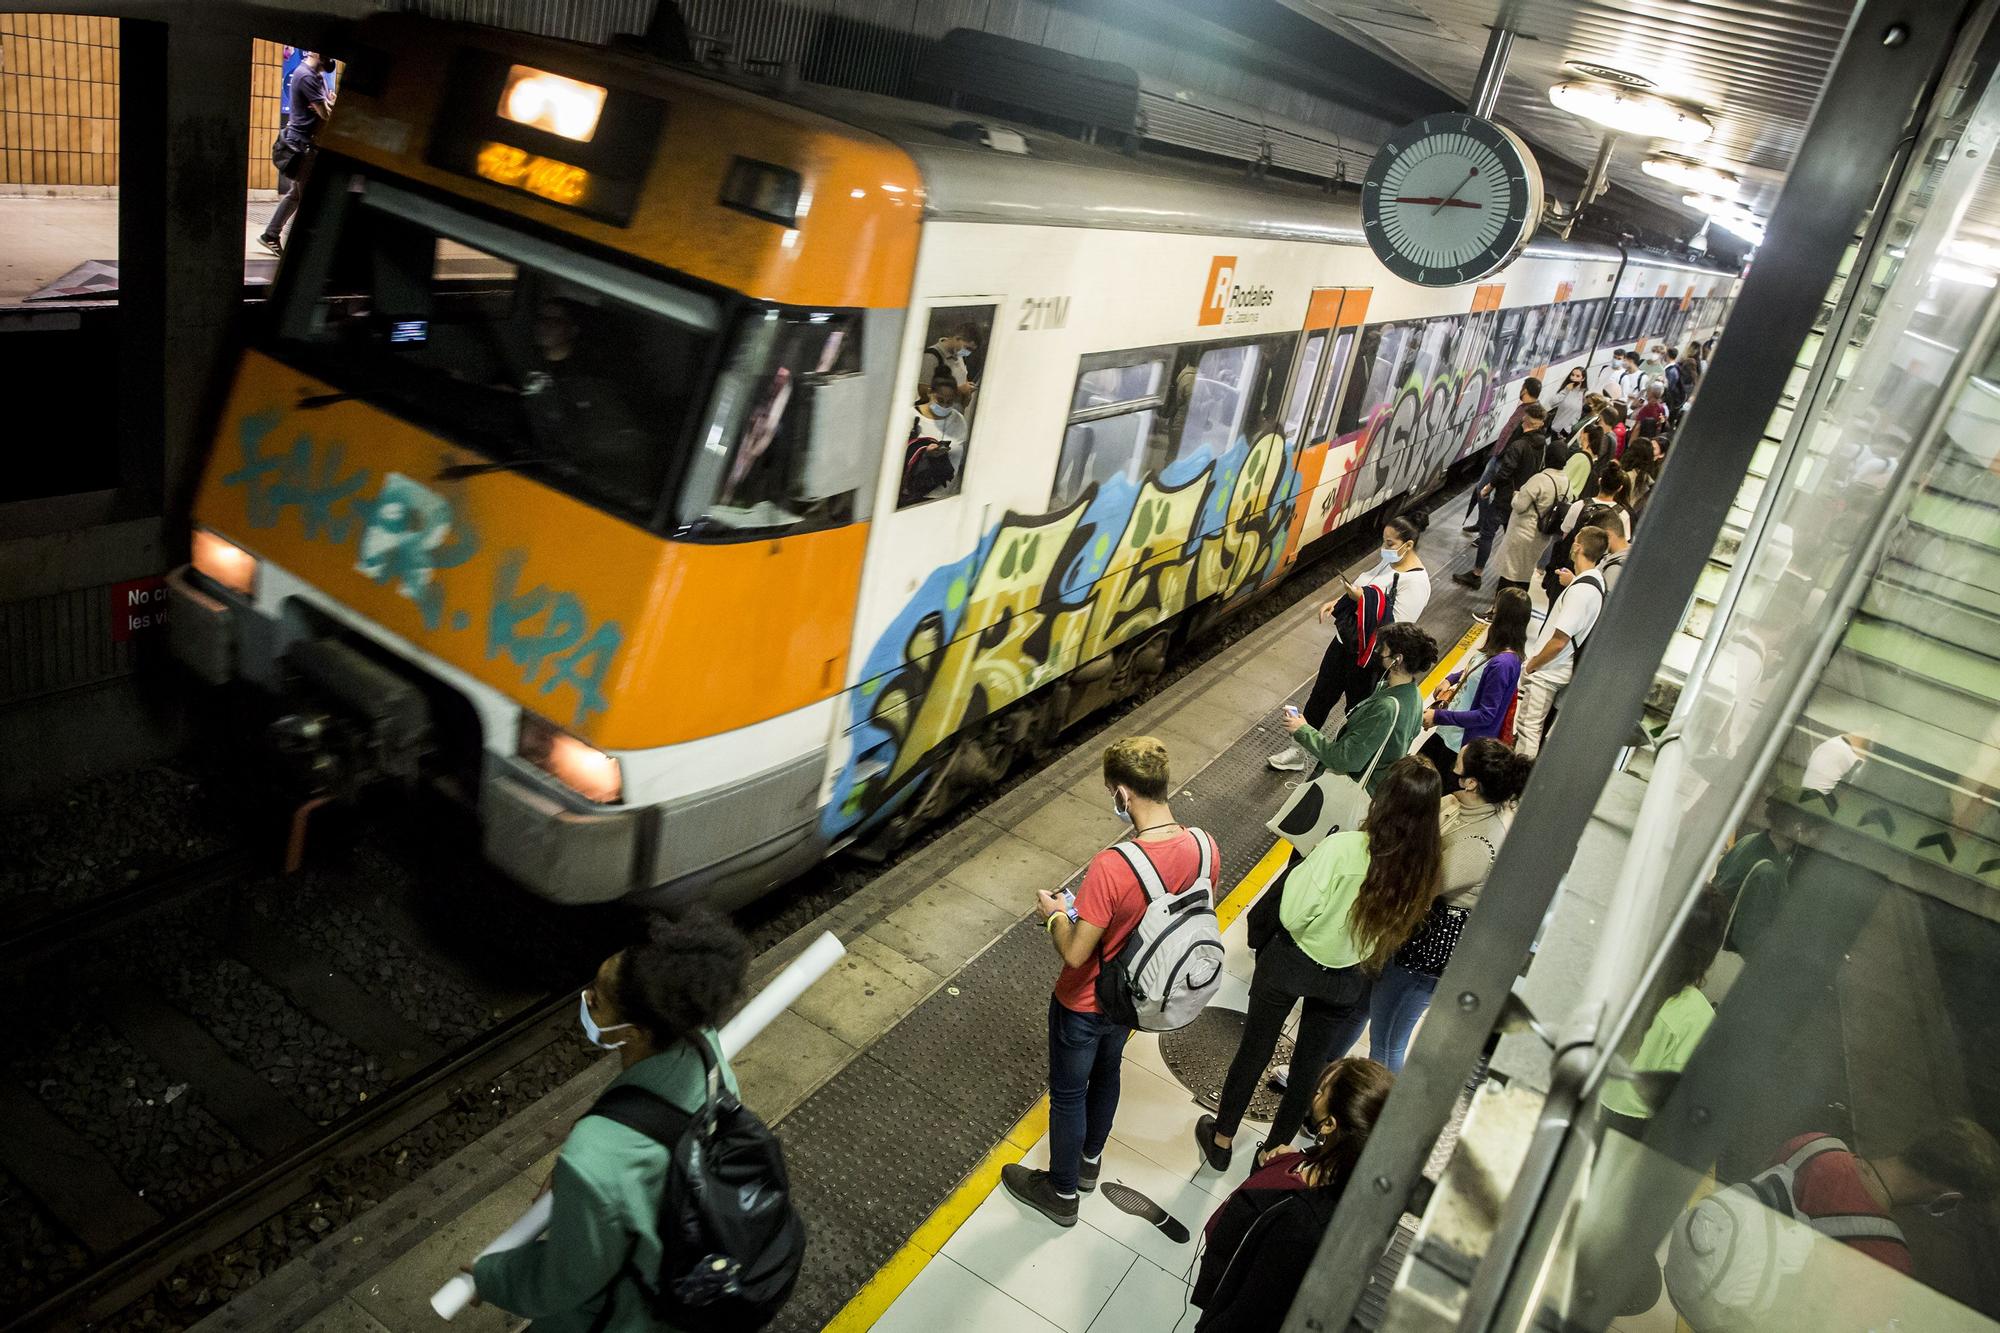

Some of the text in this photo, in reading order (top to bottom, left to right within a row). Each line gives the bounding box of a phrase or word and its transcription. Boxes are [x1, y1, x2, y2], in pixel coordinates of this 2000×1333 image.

[1424, 121, 1430, 133] 11
[1462, 118, 1470, 132] 12
[1386, 144, 1398, 156] 10
[1384, 252, 1396, 262] 7
[1418, 269, 1425, 282] 6
[1457, 265, 1464, 281] 5
[128, 587, 169, 607] No cr
[128, 608, 168, 631] les vi
